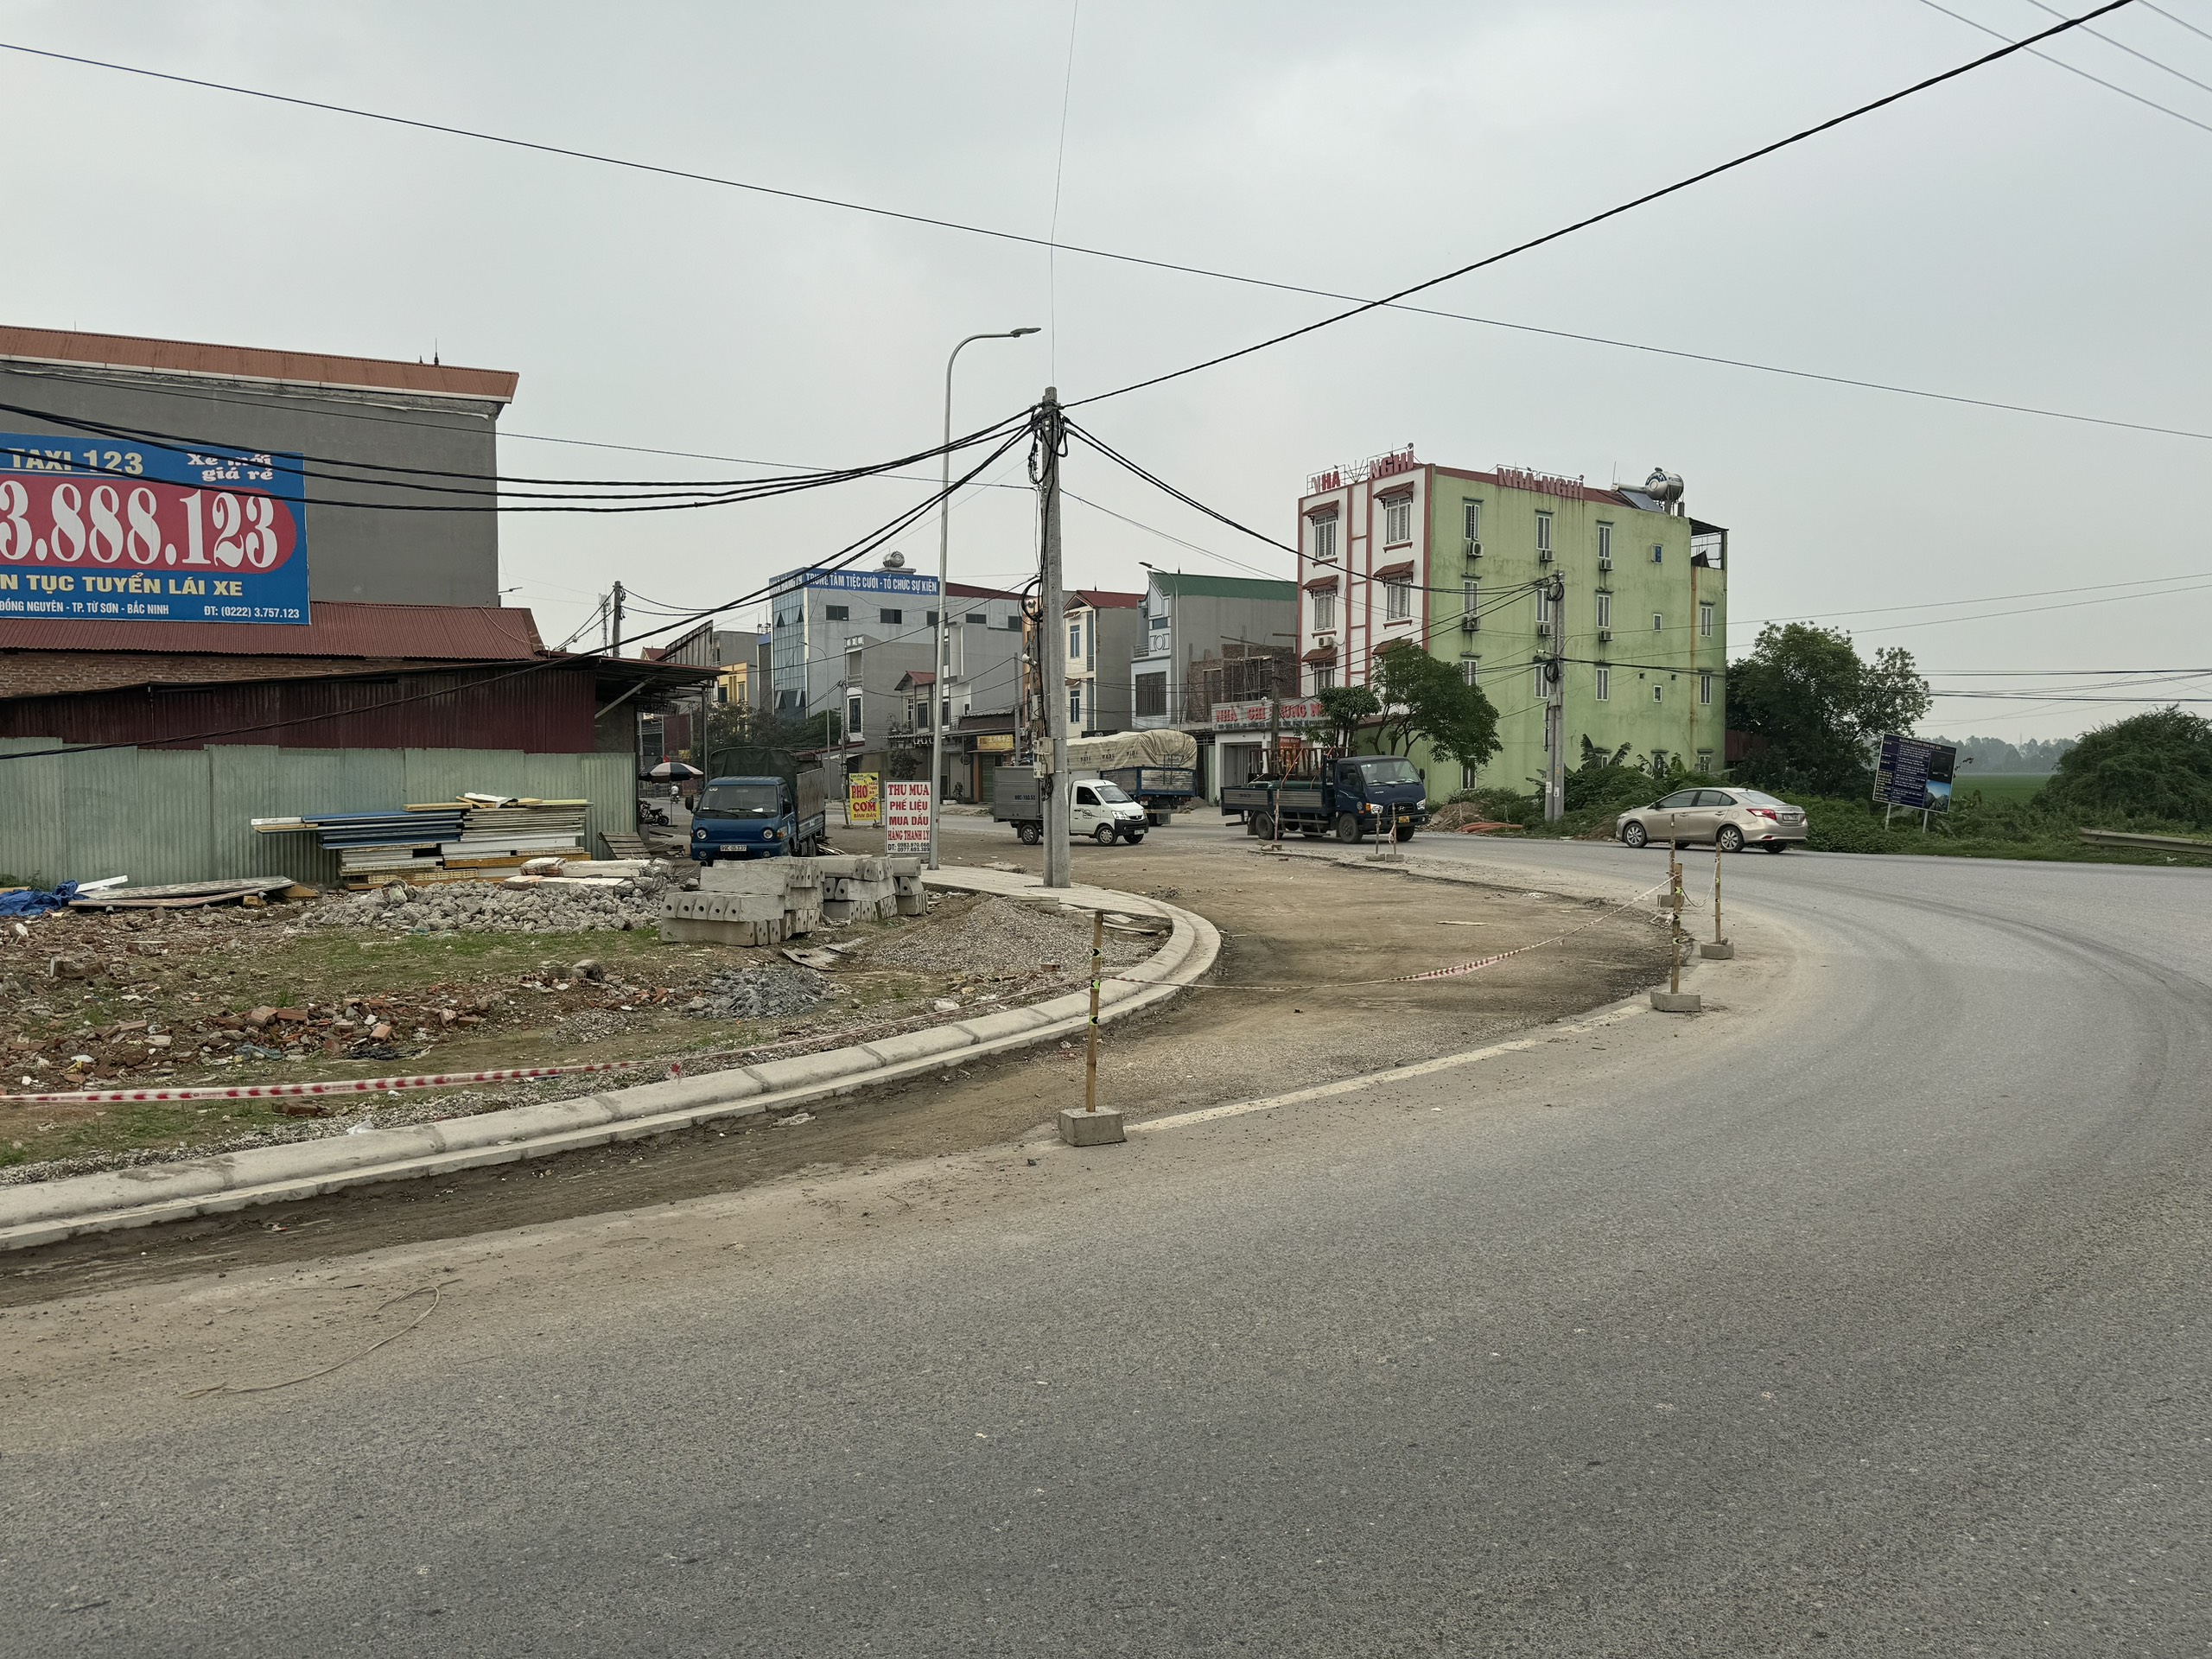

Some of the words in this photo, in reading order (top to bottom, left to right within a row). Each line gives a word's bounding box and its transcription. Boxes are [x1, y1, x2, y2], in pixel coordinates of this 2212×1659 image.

[7, 448, 72, 471] TAXI
[83, 449, 143, 475] 123
[187, 453, 219, 466] Xe
[201, 467, 240, 482] giá
[247, 467, 273, 480] rẻ
[1497, 467, 1535, 492] NHÀ
[1541, 474, 1585, 499] NGHỈ
[26, 575, 74, 594] TỤC
[82, 572, 161, 594] TUYỂN
[168, 576, 206, 595] LÁI
[213, 580, 243, 596] XE
[830, 572, 844, 587] TÂM
[846, 574, 861, 589] TIỆC
[883, 574, 892, 588] TỔ
[893, 576, 911, 591] CHỨC
[912, 580, 921, 594] SỰ
[921, 579, 938, 594] KIỆN
[27, 600, 64, 613] NGUYÊN
[72, 602, 85, 613] TP.
[86, 601, 99, 613] TỪ
[100, 602, 119, 613] SƠN
[127, 601, 145, 614] BẮC
[147, 604, 169, 615] NINH
[204, 606, 219, 616] ĐT:
[221, 607, 251, 618] (0222)
[254, 607, 300, 619] 3.757.123
[887, 784, 907, 796] THU
[909, 784, 930, 796] MUA
[890, 798, 906, 810] PHẾ
[909, 799, 928, 812] LIỆU
[889, 817, 909, 826] MUA
[887, 827, 903, 841] HÀNG
[904, 830, 922, 841] THANH
[923, 827, 930, 841] LÝ
